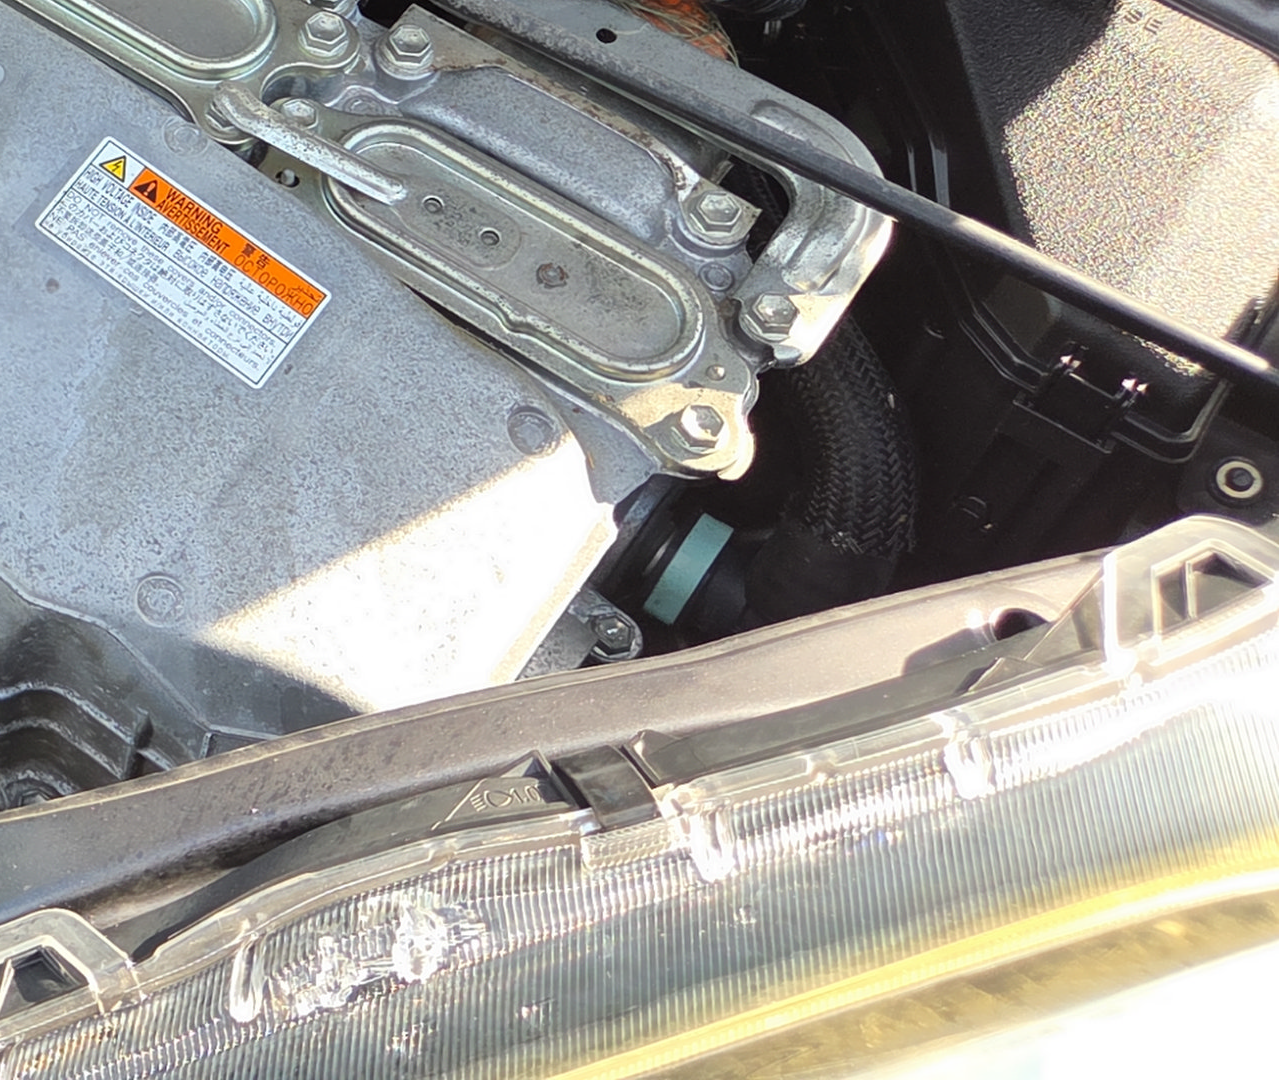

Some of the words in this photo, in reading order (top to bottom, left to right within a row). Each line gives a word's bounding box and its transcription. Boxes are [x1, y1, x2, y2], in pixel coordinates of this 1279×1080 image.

[73, 178, 101, 201] HAUTE
[94, 194, 127, 220] TENSION
[82, 166, 105, 186] HIGH
[100, 179, 135, 208] VOLTAGE
[130, 201, 158, 224] INSIDE
[162, 187, 225, 235] WARNING
[65, 190, 83, 205] DO
[83, 202, 106, 221] NOT
[105, 219, 139, 246] remove
[139, 244, 166, 265] these
[165, 263, 196, 288] covers
[197, 285, 227, 310] and/or
[154, 197, 230, 255] AVERTISSEMENT
[65, 224, 87, 242] PAS
[87, 240, 121, 267] enlever
[121, 266, 140, 282] ces
[141, 280, 190, 318] couvercles
[190, 316, 202, 327] et
[231, 252, 315, 317] ОСТОРОЖНО
